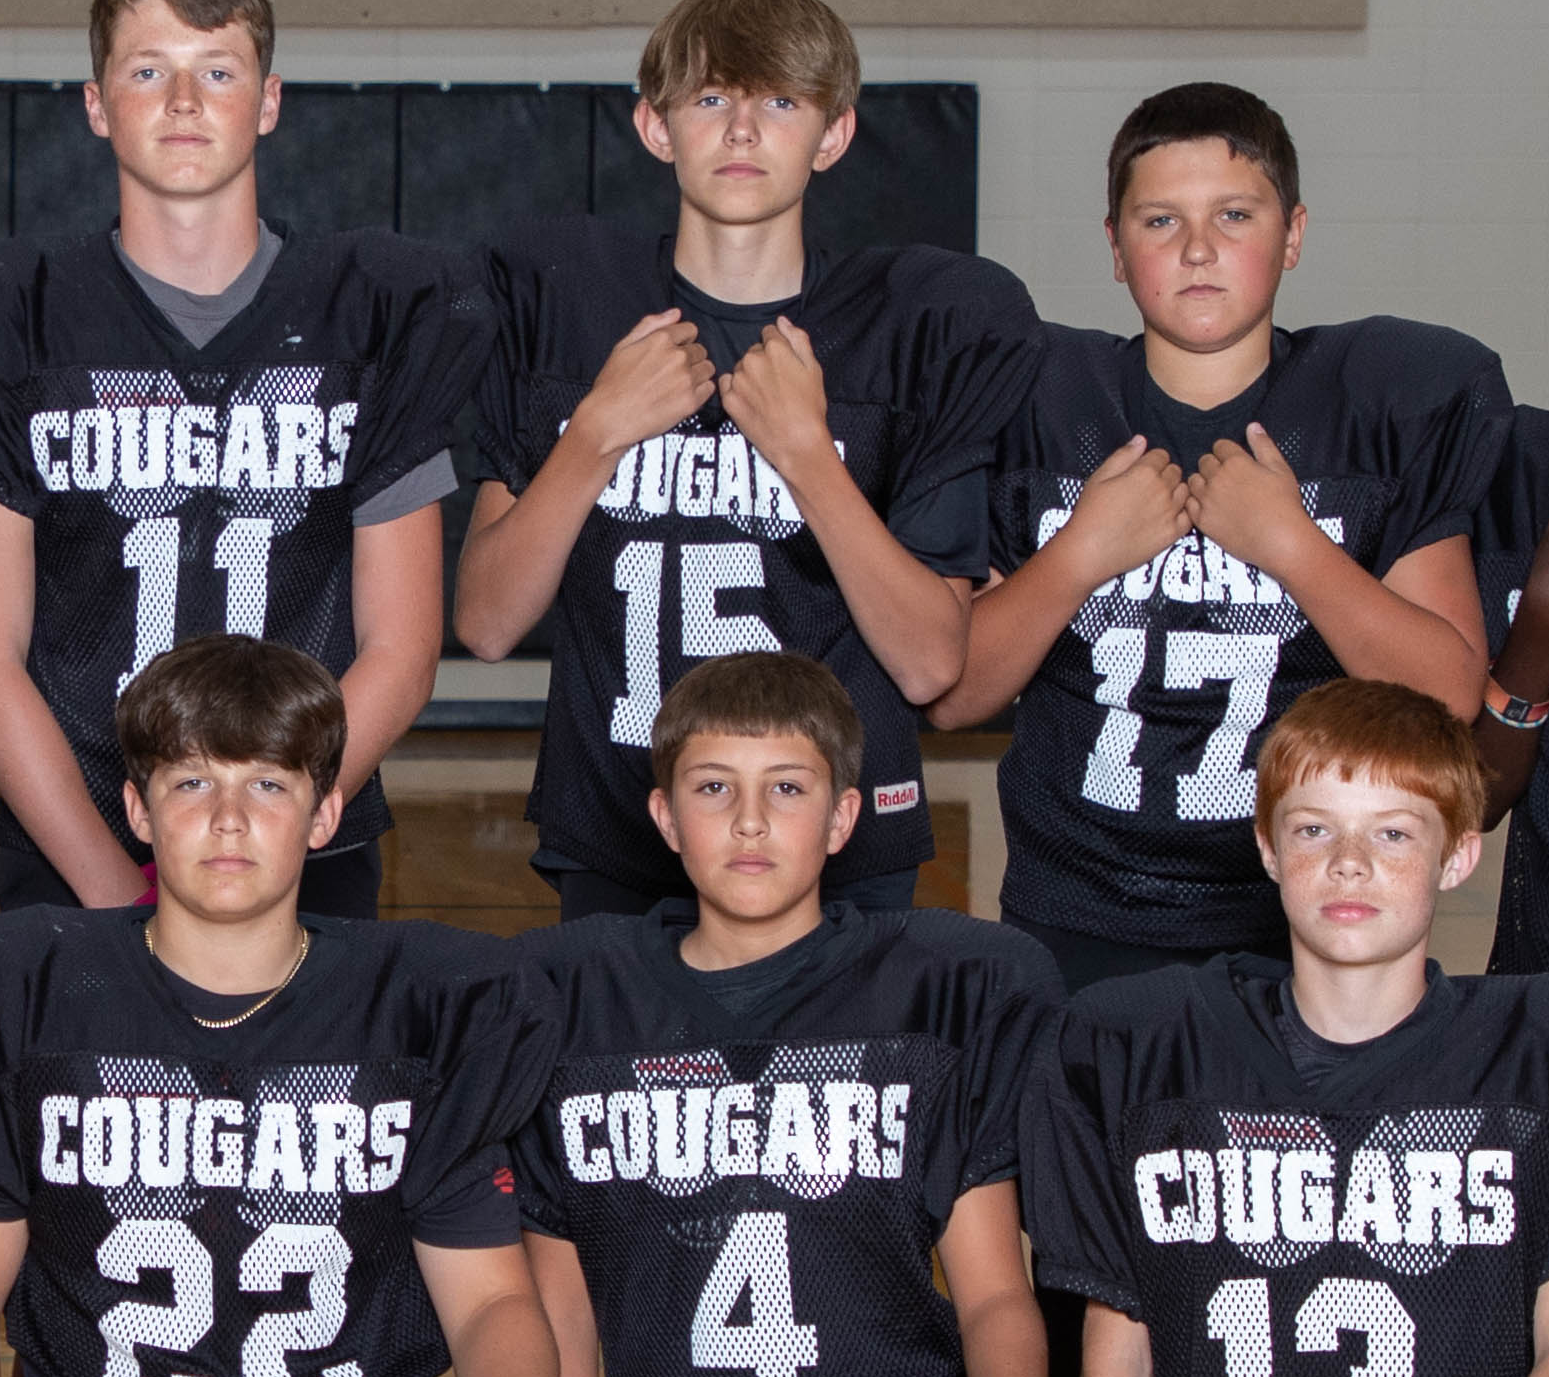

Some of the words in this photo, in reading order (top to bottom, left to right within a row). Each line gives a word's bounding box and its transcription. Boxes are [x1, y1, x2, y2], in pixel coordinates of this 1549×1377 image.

[29, 401, 358, 492] COUGARS
[1081, 626, 1282, 821] 17
[40, 1095, 413, 1194] COUGARS
[560, 1081, 911, 1183] COUGARS
[1135, 1149, 1517, 1246] COUGARS
